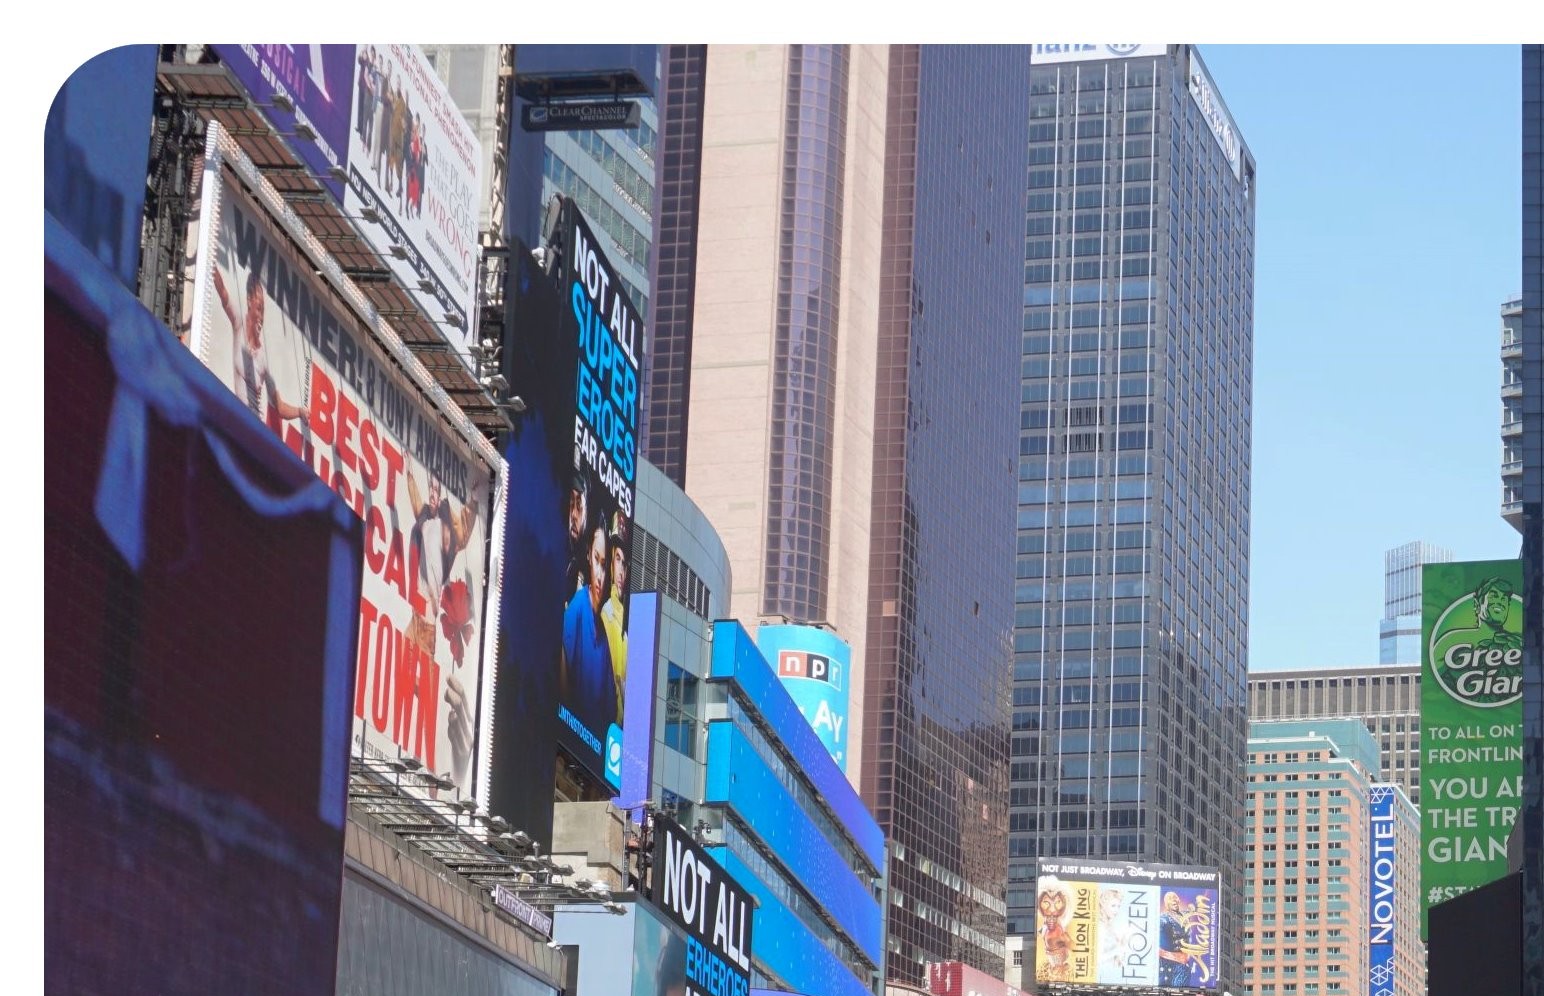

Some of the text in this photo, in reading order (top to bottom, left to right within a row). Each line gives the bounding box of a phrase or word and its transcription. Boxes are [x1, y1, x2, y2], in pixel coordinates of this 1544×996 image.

[428, 187, 472, 278] WRONG
[574, 225, 610, 314] NOT
[611, 291, 639, 371] ALL
[233, 203, 364, 394] WINNER!
[379, 370, 414, 444] TONY
[416, 410, 469, 502] AWARDS
[571, 281, 637, 431] SUPER
[309, 362, 403, 507] BEST
[576, 356, 635, 482] EROES
[598, 450, 632, 519] CAPES
[354, 596, 440, 772] TOWN
[785, 655, 840, 681] npr
[1444, 643, 1522, 679] Gree
[1428, 724, 1515, 741] TO ALL ON
[1428, 807, 1477, 838] THE
[1429, 776, 1488, 810] YOU
[662, 829, 749, 972] NOT ALL
[1041, 864, 1216, 881] NOT JUST BROADWAY, Disney ON BROADWAY
[1371, 803, 1396, 945] NOVOTEL
[1073, 888, 1090, 979] THE LION KING
[1122, 890, 1151, 979] FROZEN
